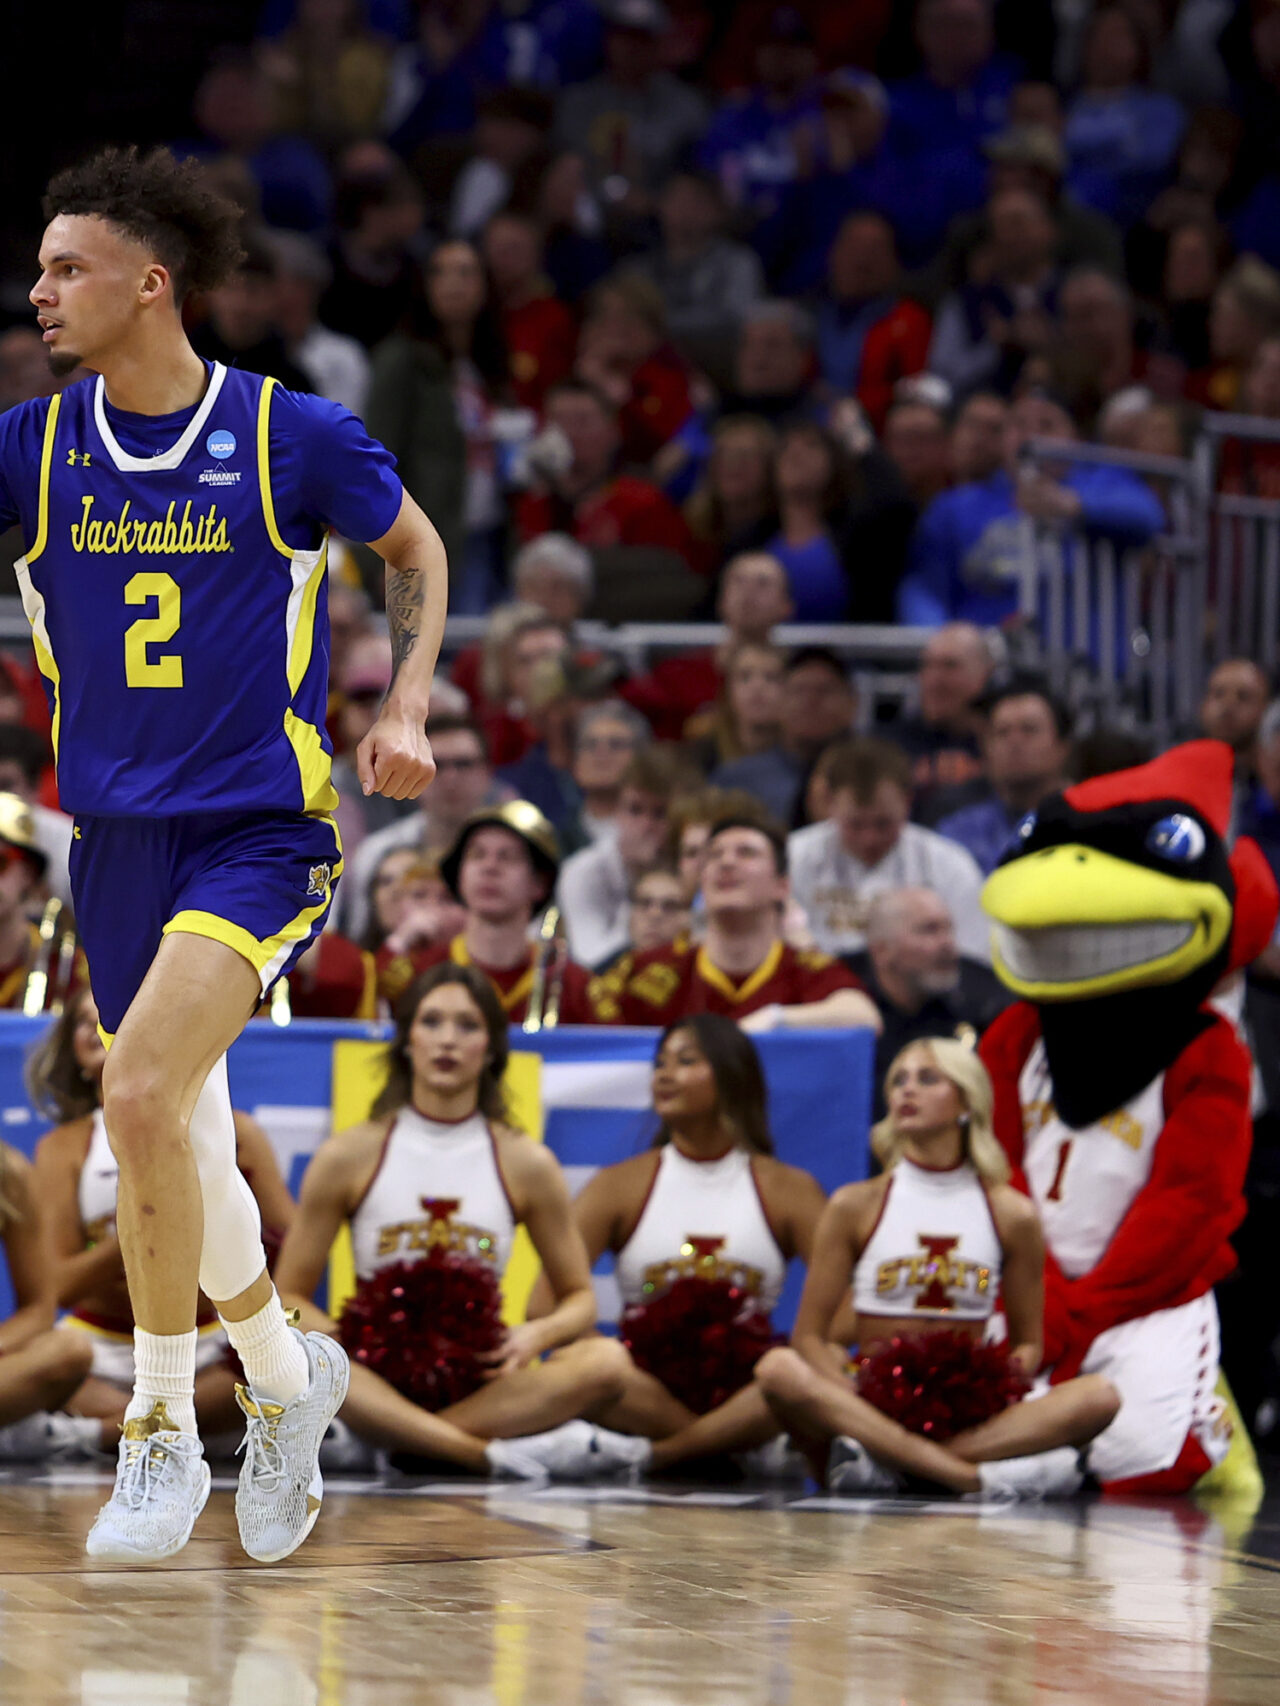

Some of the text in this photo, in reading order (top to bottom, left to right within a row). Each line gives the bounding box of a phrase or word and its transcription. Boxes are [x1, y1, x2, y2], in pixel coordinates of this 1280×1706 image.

[198, 472, 241, 483] SUMMIT
[71, 495, 231, 554] Jackrabbits
[124, 572, 183, 688] 2
